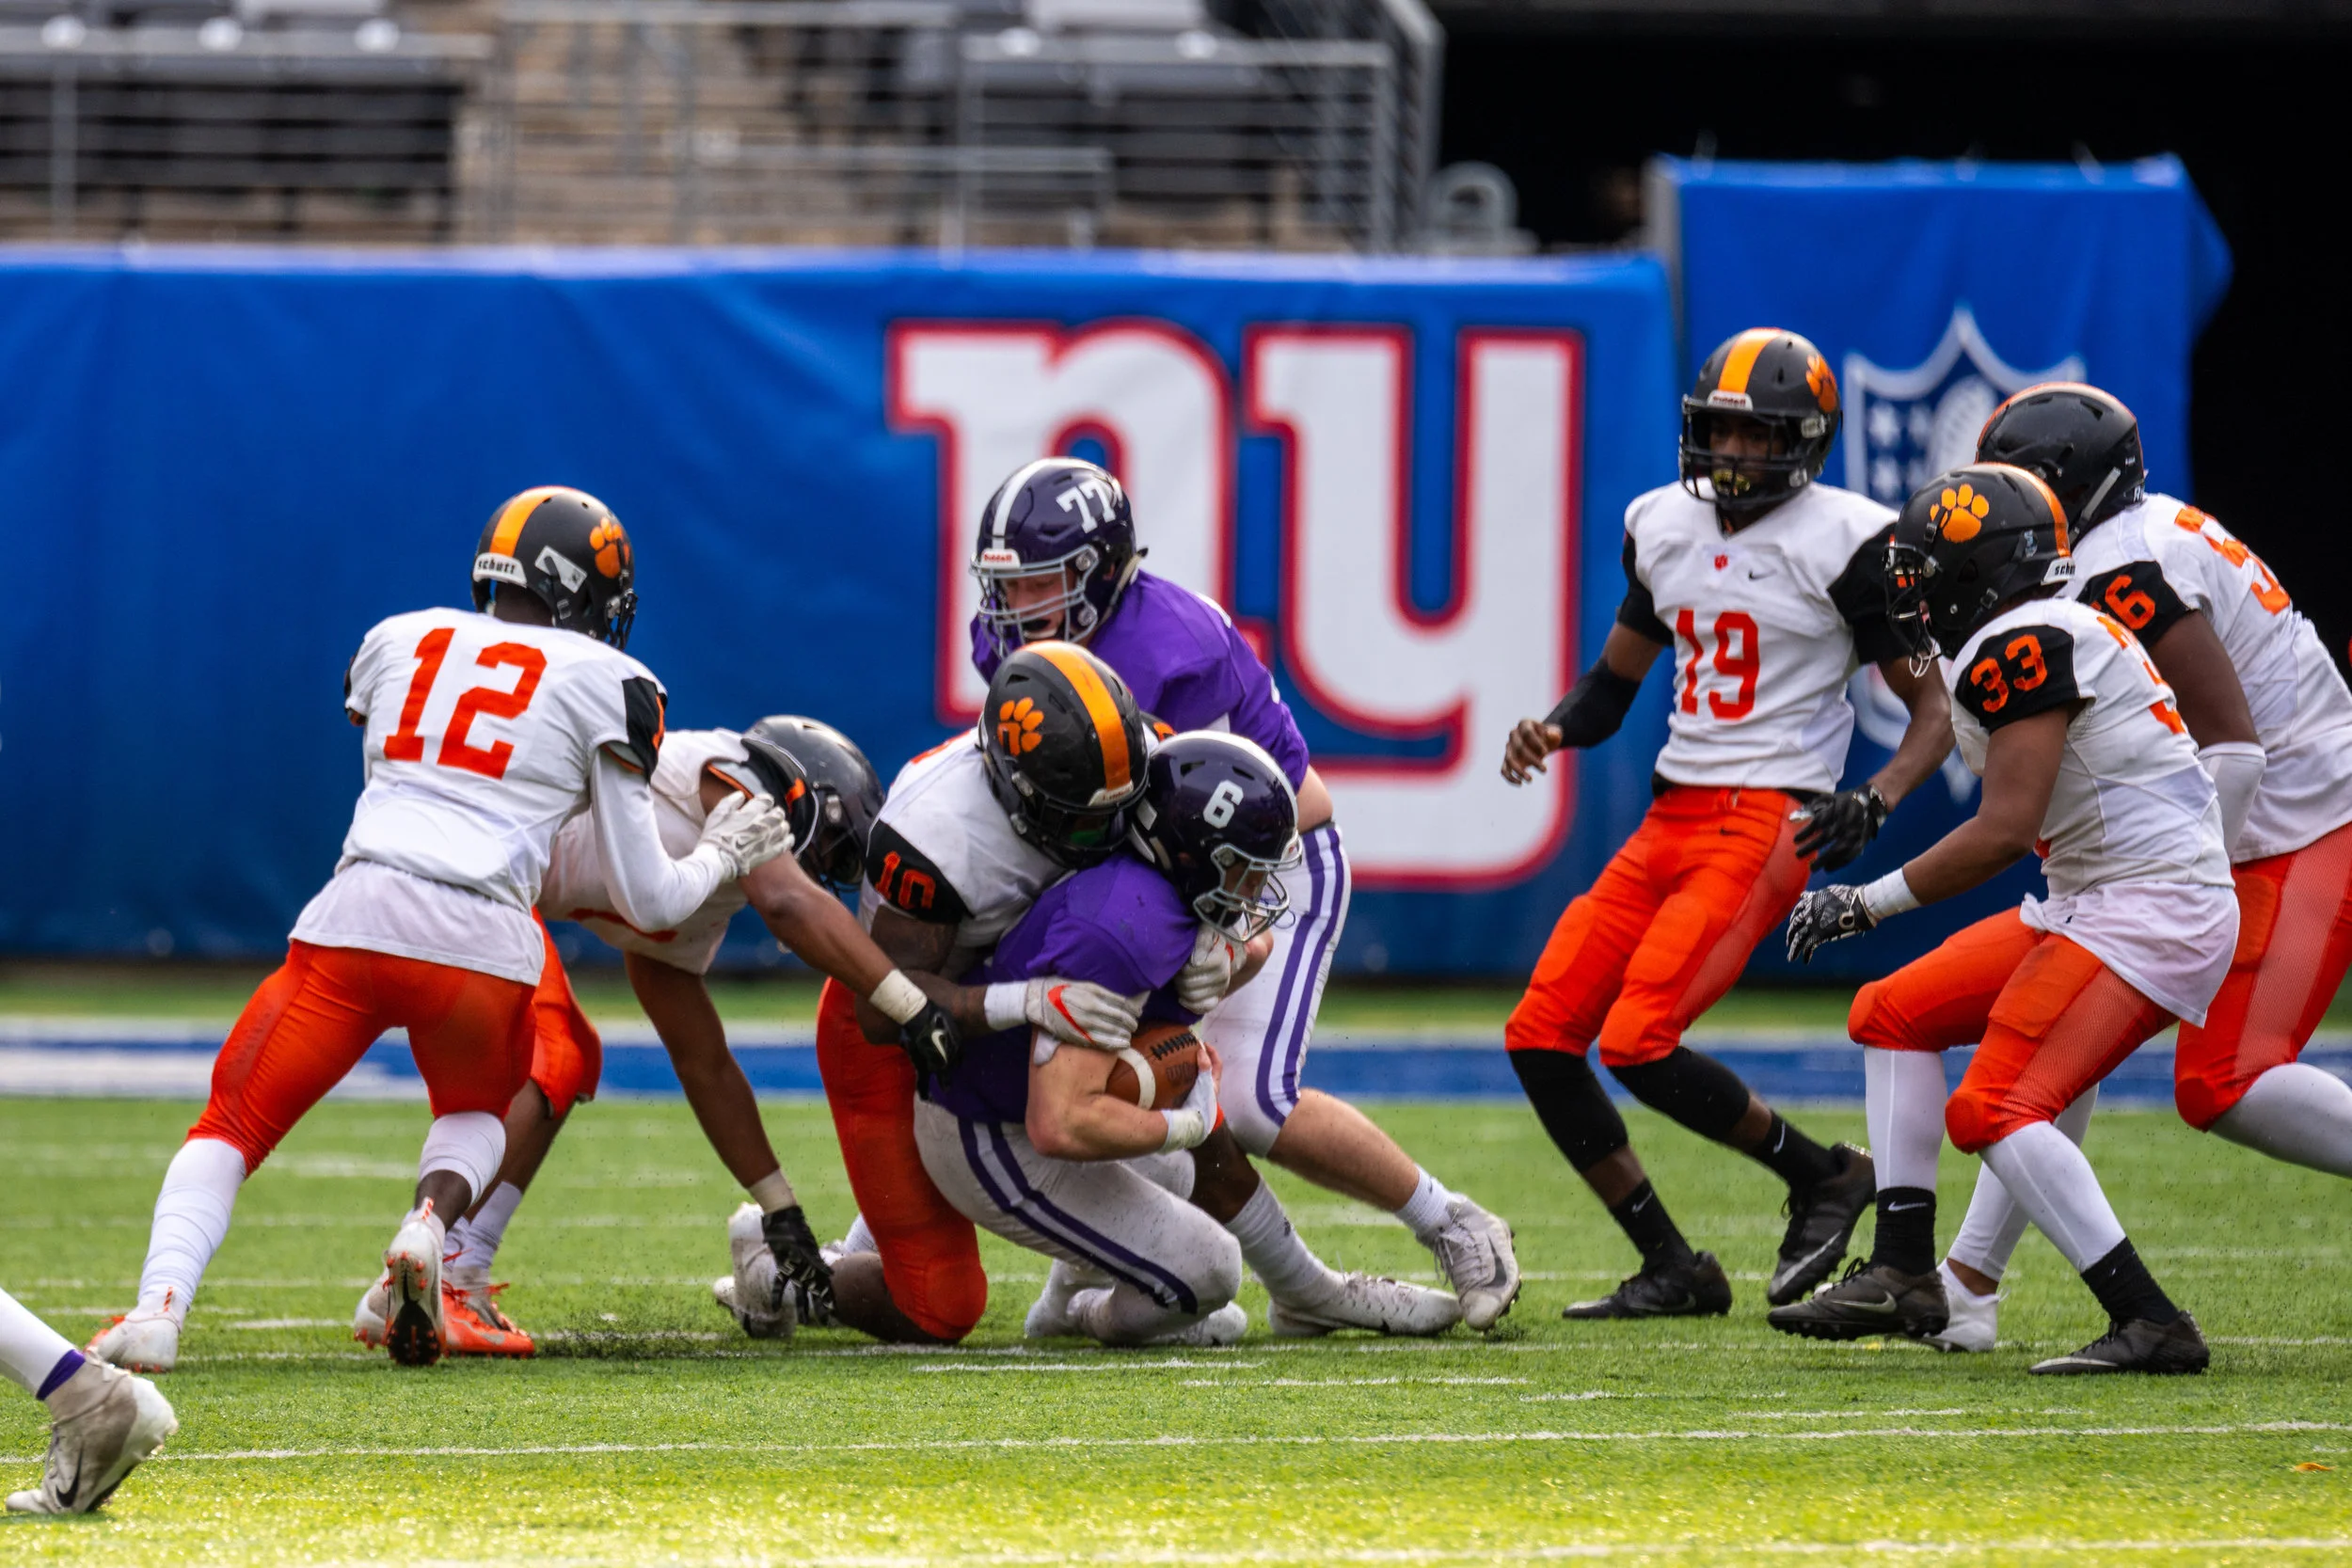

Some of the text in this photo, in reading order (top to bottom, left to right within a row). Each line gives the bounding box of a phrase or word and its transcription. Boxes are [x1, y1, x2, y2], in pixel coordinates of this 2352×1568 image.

[1056, 480, 1116, 533] 77
[2090, 575, 2155, 630] 6
[1677, 610, 1760, 720] 19
[1971, 634, 2047, 713] 33
[383, 627, 548, 781] 12
[1203, 779, 1244, 829] 6
[875, 850, 936, 911] 10
